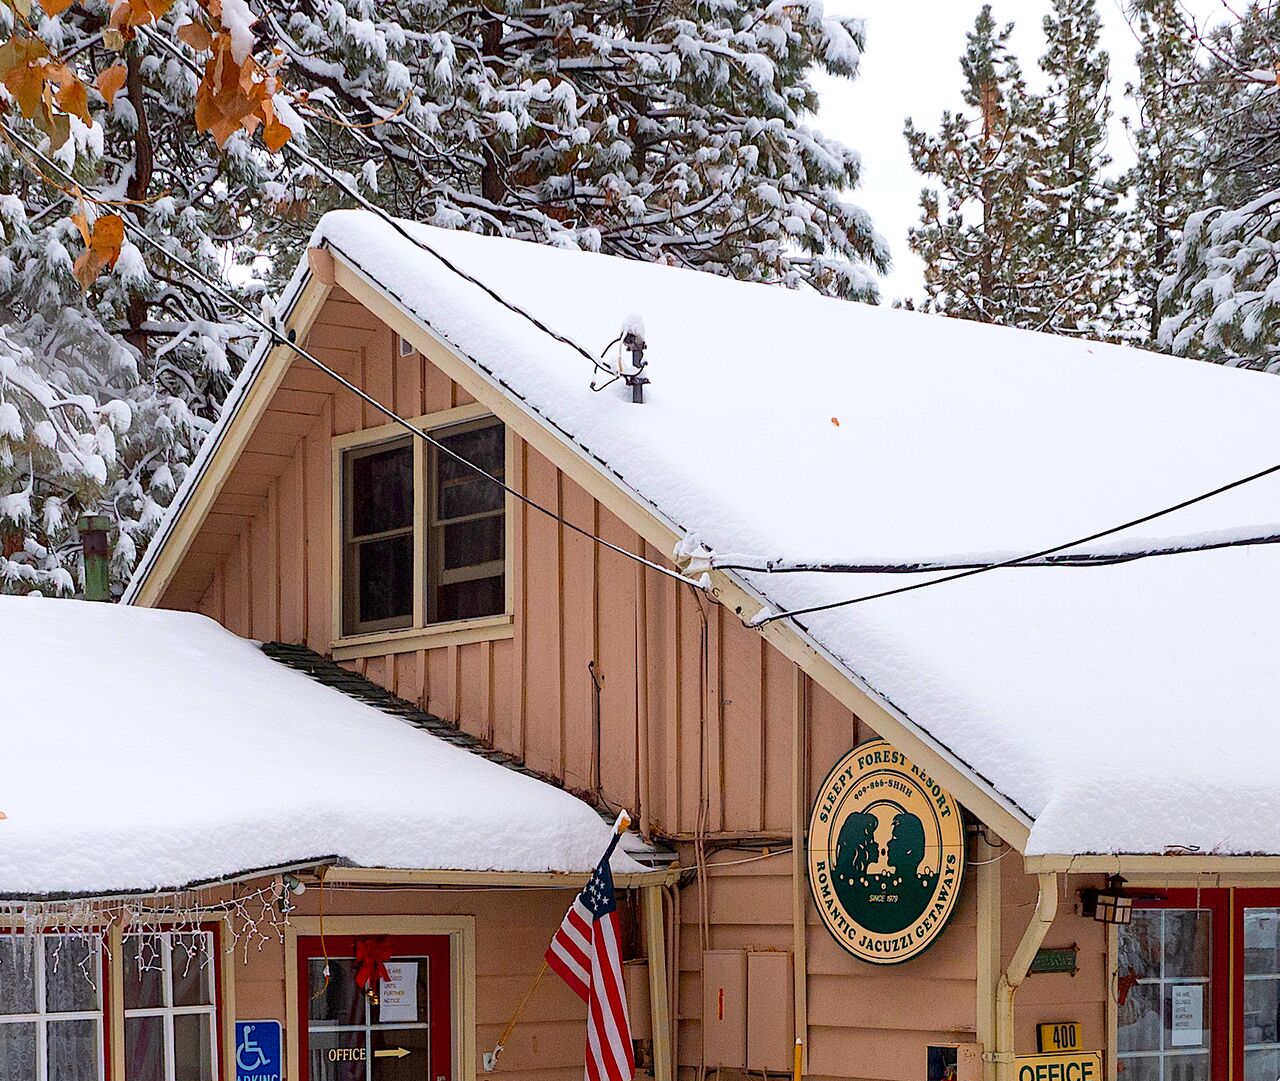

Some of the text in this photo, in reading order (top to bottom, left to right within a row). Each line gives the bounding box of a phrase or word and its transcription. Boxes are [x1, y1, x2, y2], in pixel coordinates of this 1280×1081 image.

[820, 766, 853, 823] SLEEPY
[857, 750, 907, 770] FOREST
[854, 779, 913, 800] 909-866-SHHH
[816, 854, 956, 952] ROMANTIC JACUZZI GETAWAYS
[869, 894, 886, 902] SINCE
[1053, 1024, 1076, 1049] 400
[328, 1047, 367, 1061] OFFICE
